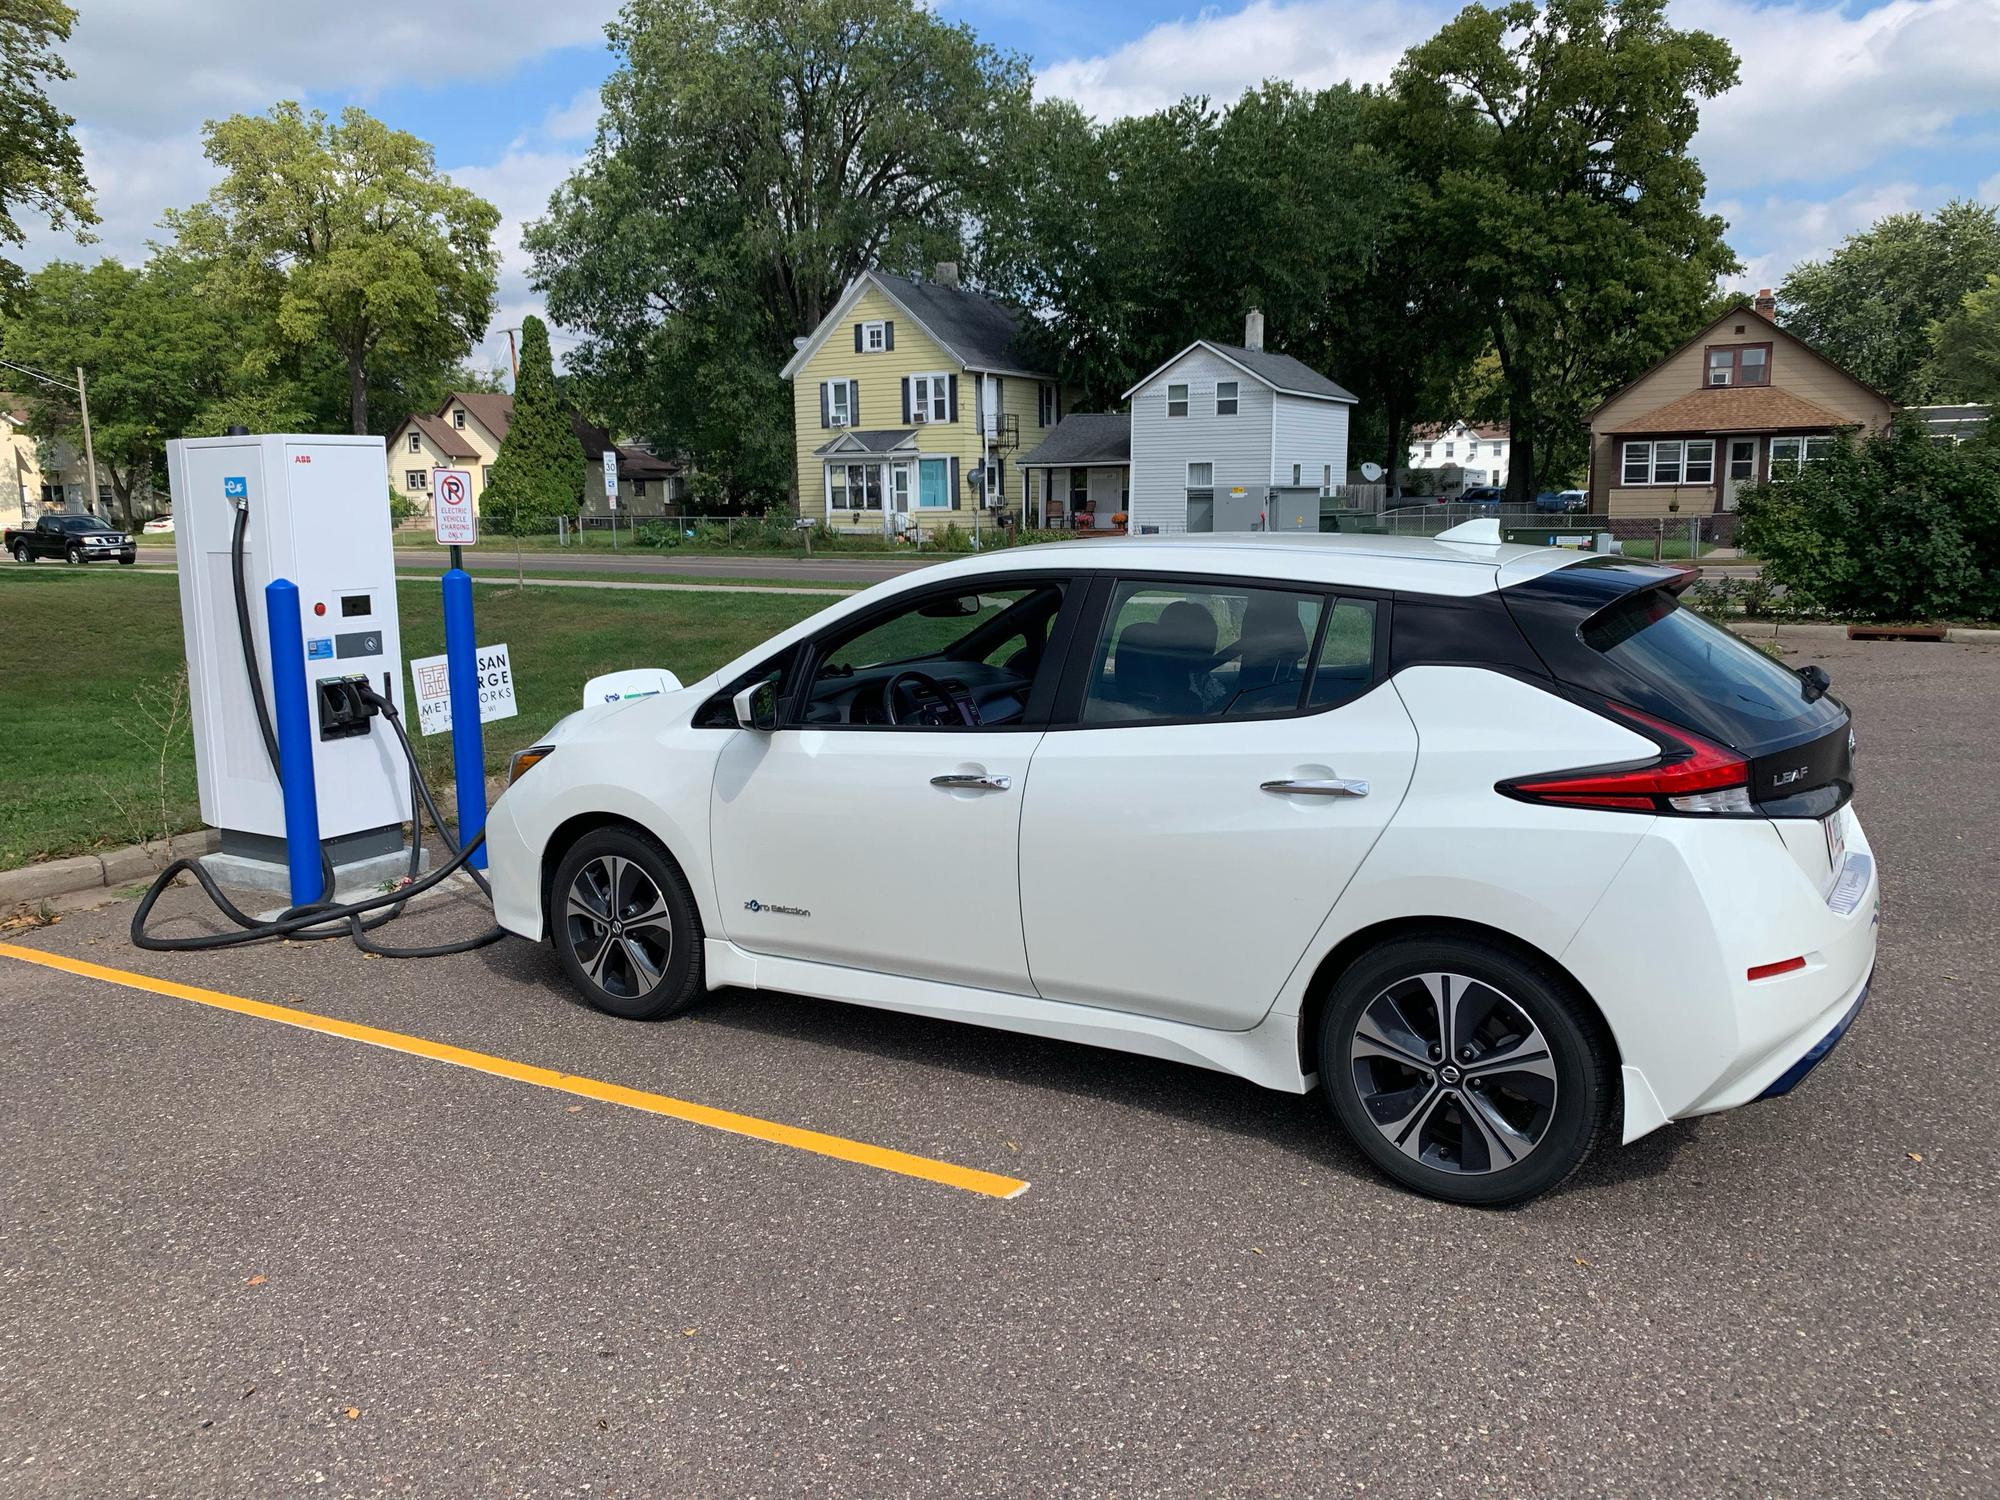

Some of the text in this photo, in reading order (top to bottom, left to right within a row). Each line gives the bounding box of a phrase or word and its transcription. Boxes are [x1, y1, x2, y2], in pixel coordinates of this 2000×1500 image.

[295, 455, 311, 464] ABB
[606, 463, 616, 472] 30
[443, 515, 467, 523] VEHICLE
[440, 523, 470, 531] CHARGING
[448, 531, 464, 539] ONLY
[478, 654, 506, 671] SAN
[477, 671, 509, 689] RGE
[1773, 766, 1809, 787] LEAF
